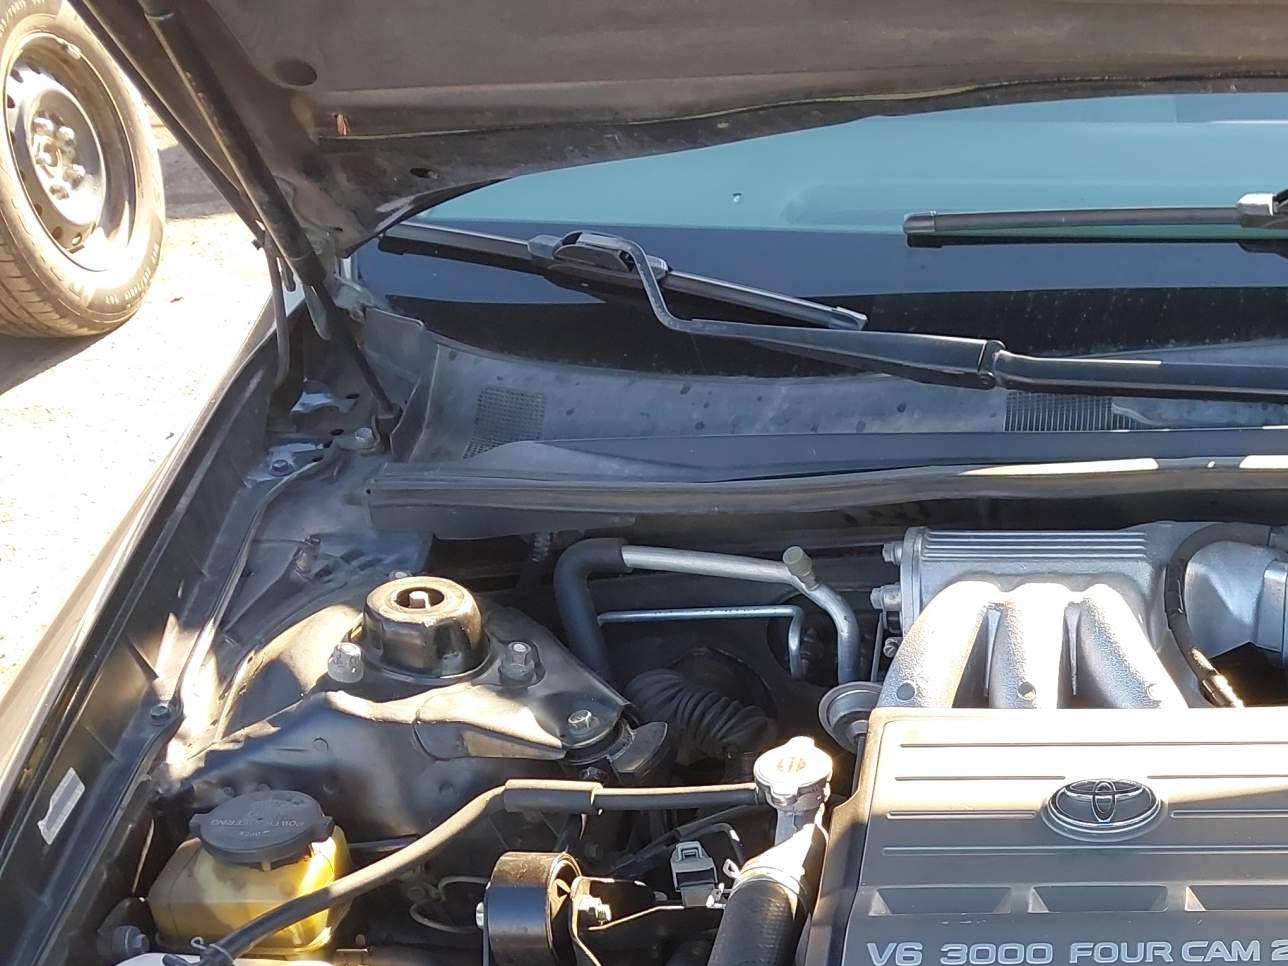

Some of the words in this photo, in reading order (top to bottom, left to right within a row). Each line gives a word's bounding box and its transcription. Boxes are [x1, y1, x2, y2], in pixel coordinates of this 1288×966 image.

[866, 942, 923, 966] V6
[939, 942, 1054, 966] 3000
[1068, 940, 1174, 965] FOUR
[1181, 940, 1261, 963] CAM
